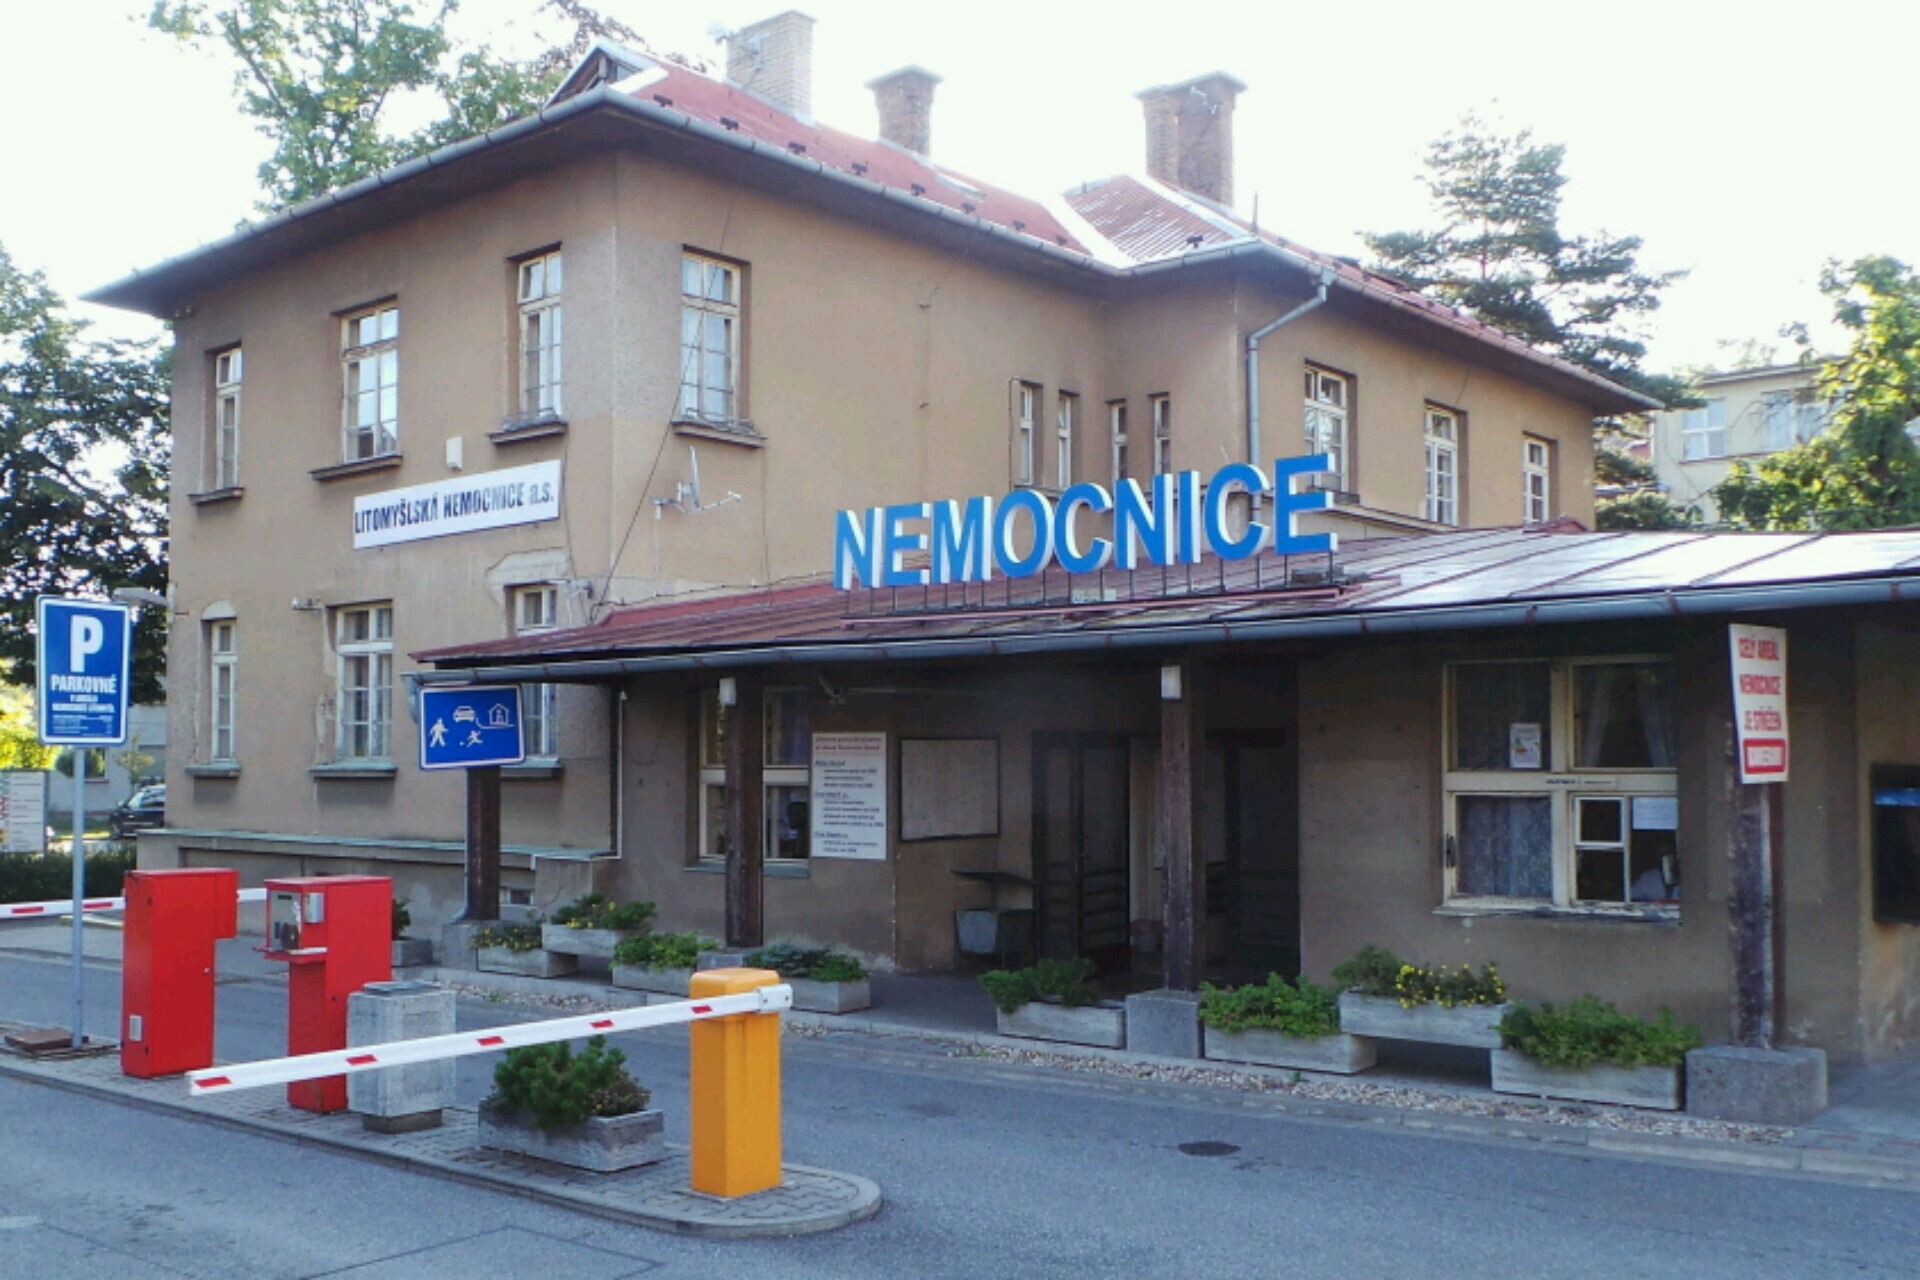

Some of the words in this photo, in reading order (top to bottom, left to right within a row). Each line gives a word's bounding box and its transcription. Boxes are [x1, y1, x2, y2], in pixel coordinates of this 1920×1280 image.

[354, 492, 438, 534] LITOMYŠLSKÁ
[443, 482, 524, 519] NEMOCNICE
[529, 482, 554, 504] a.s.
[834, 453, 1337, 590] NEMOCNICE
[70, 614, 103, 673] P
[50, 674, 117, 694] PARKOVNÉ
